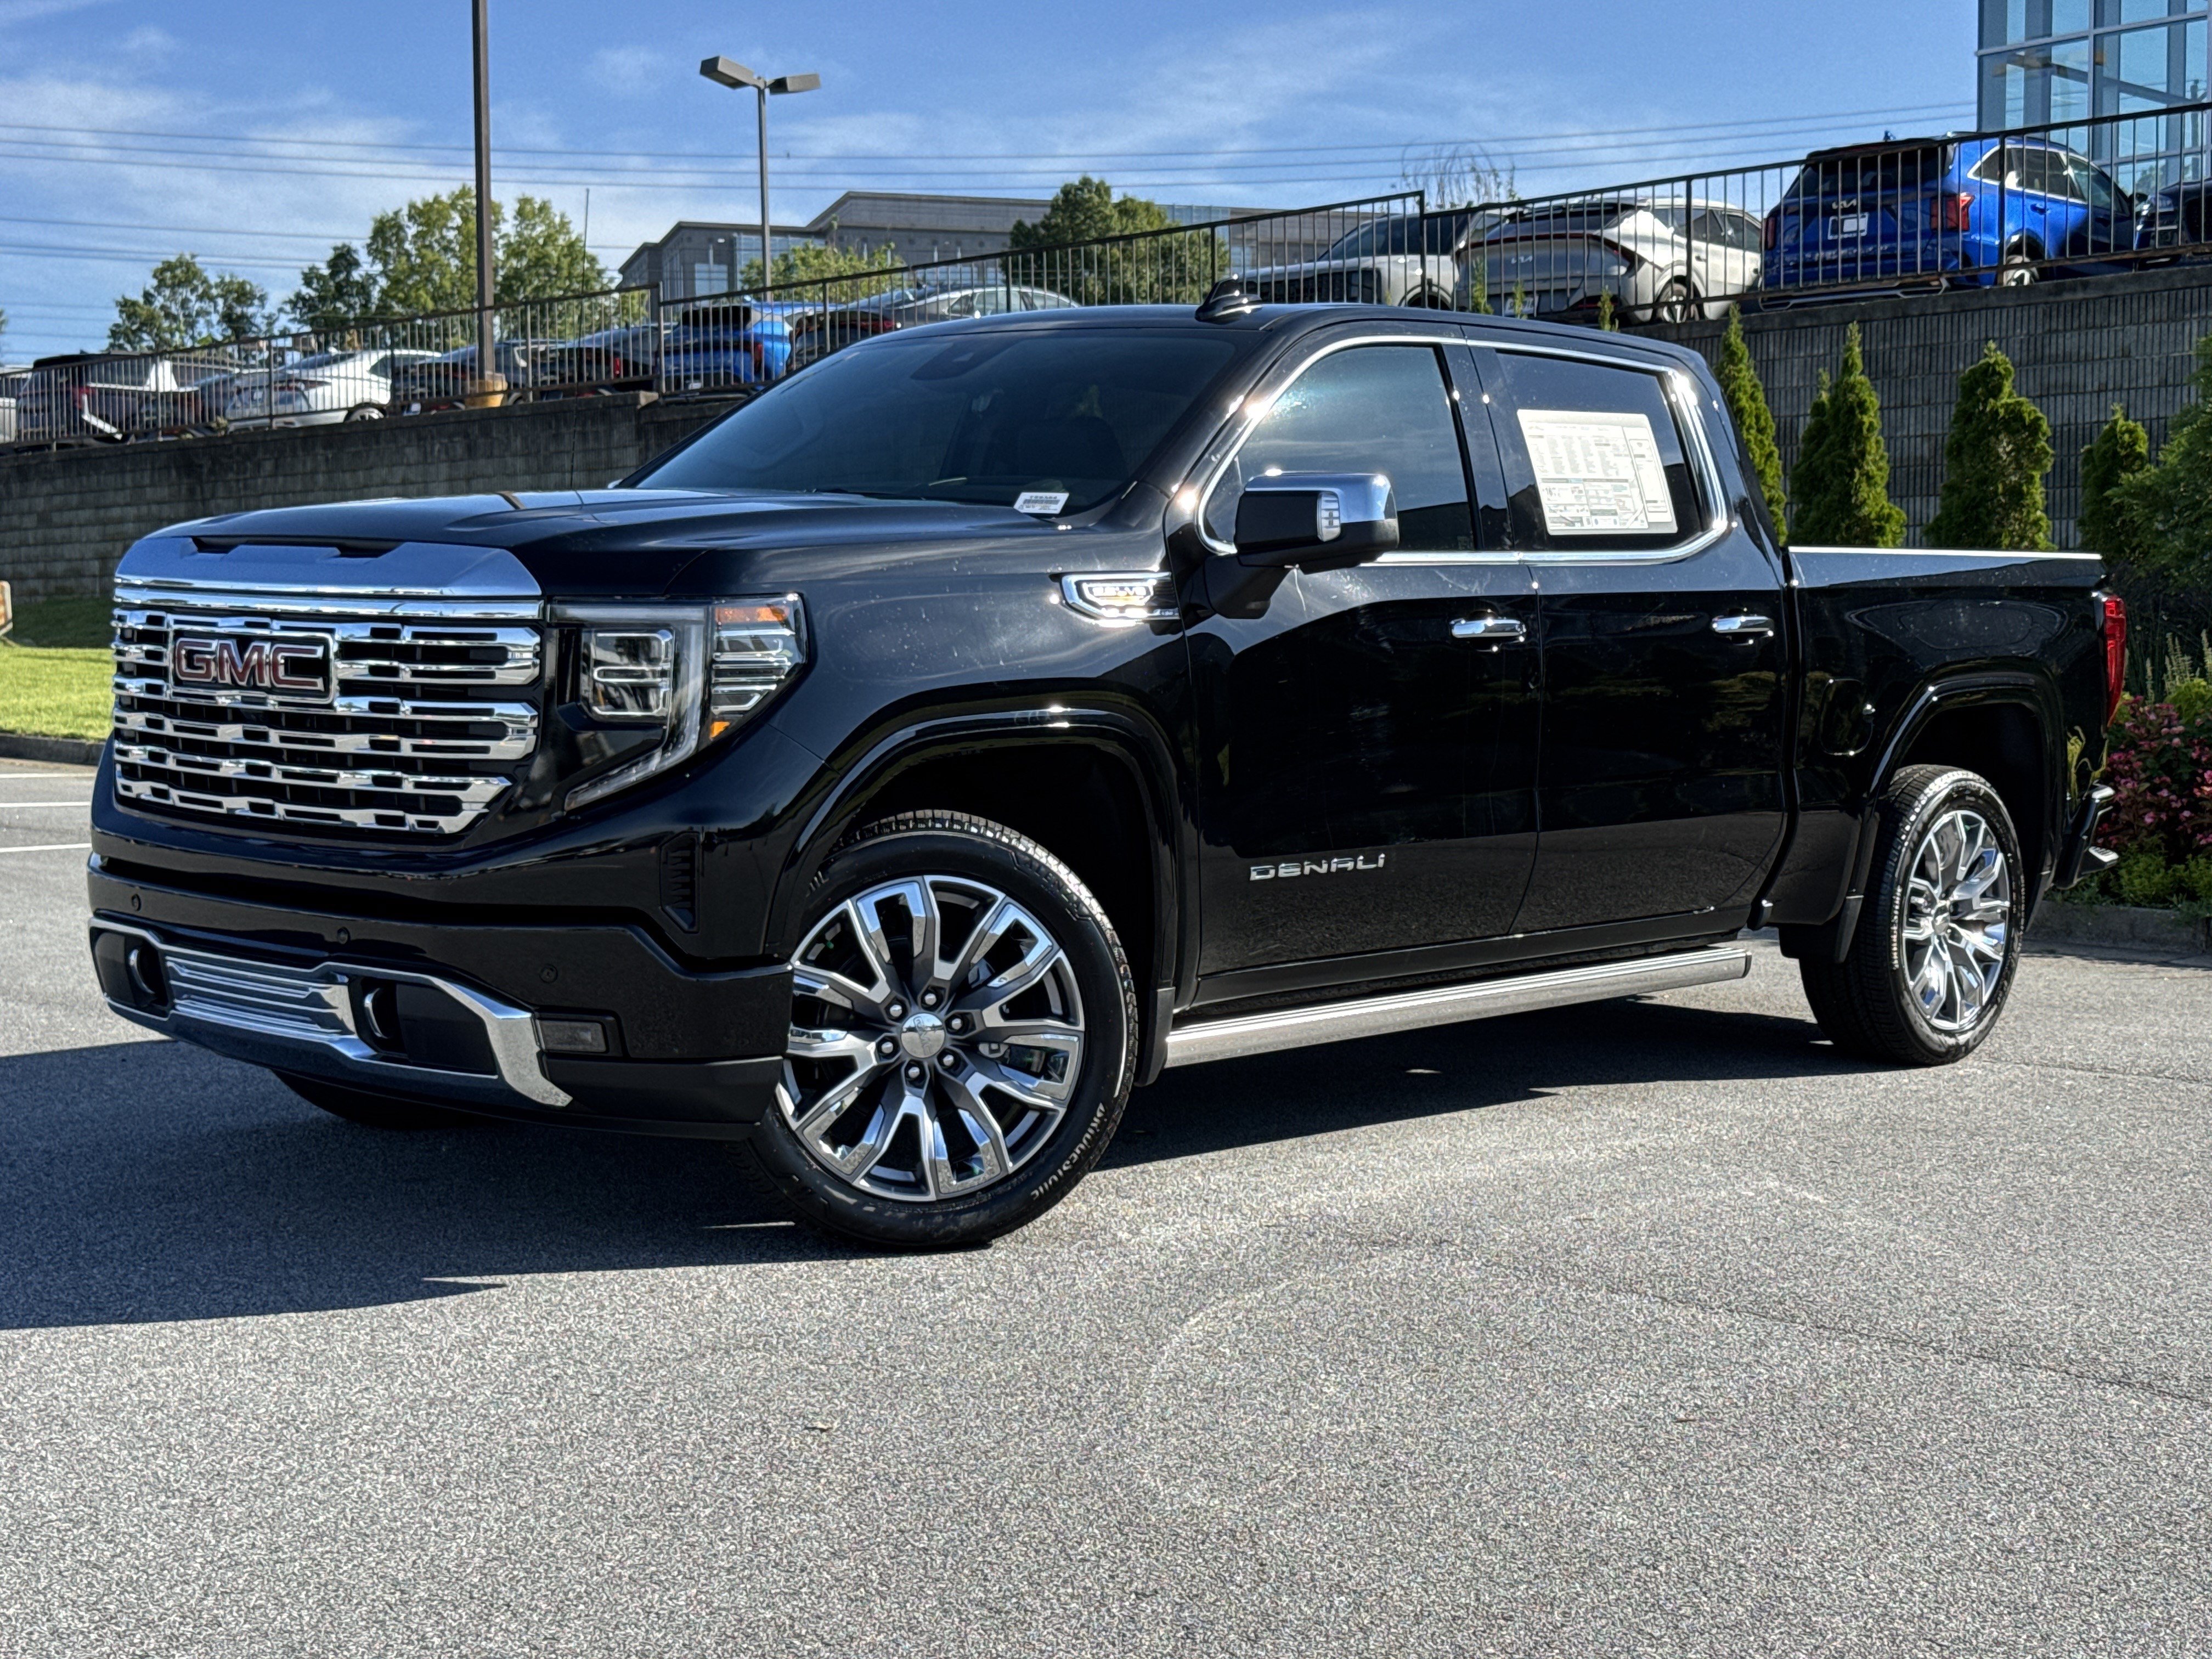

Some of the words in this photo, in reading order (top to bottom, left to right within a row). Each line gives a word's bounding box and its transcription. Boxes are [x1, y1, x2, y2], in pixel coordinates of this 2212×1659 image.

[175, 637, 325, 692] GMC
[1249, 853, 1386, 881] DENALI
[1030, 1102, 1107, 1200] BRIDGESTONE
